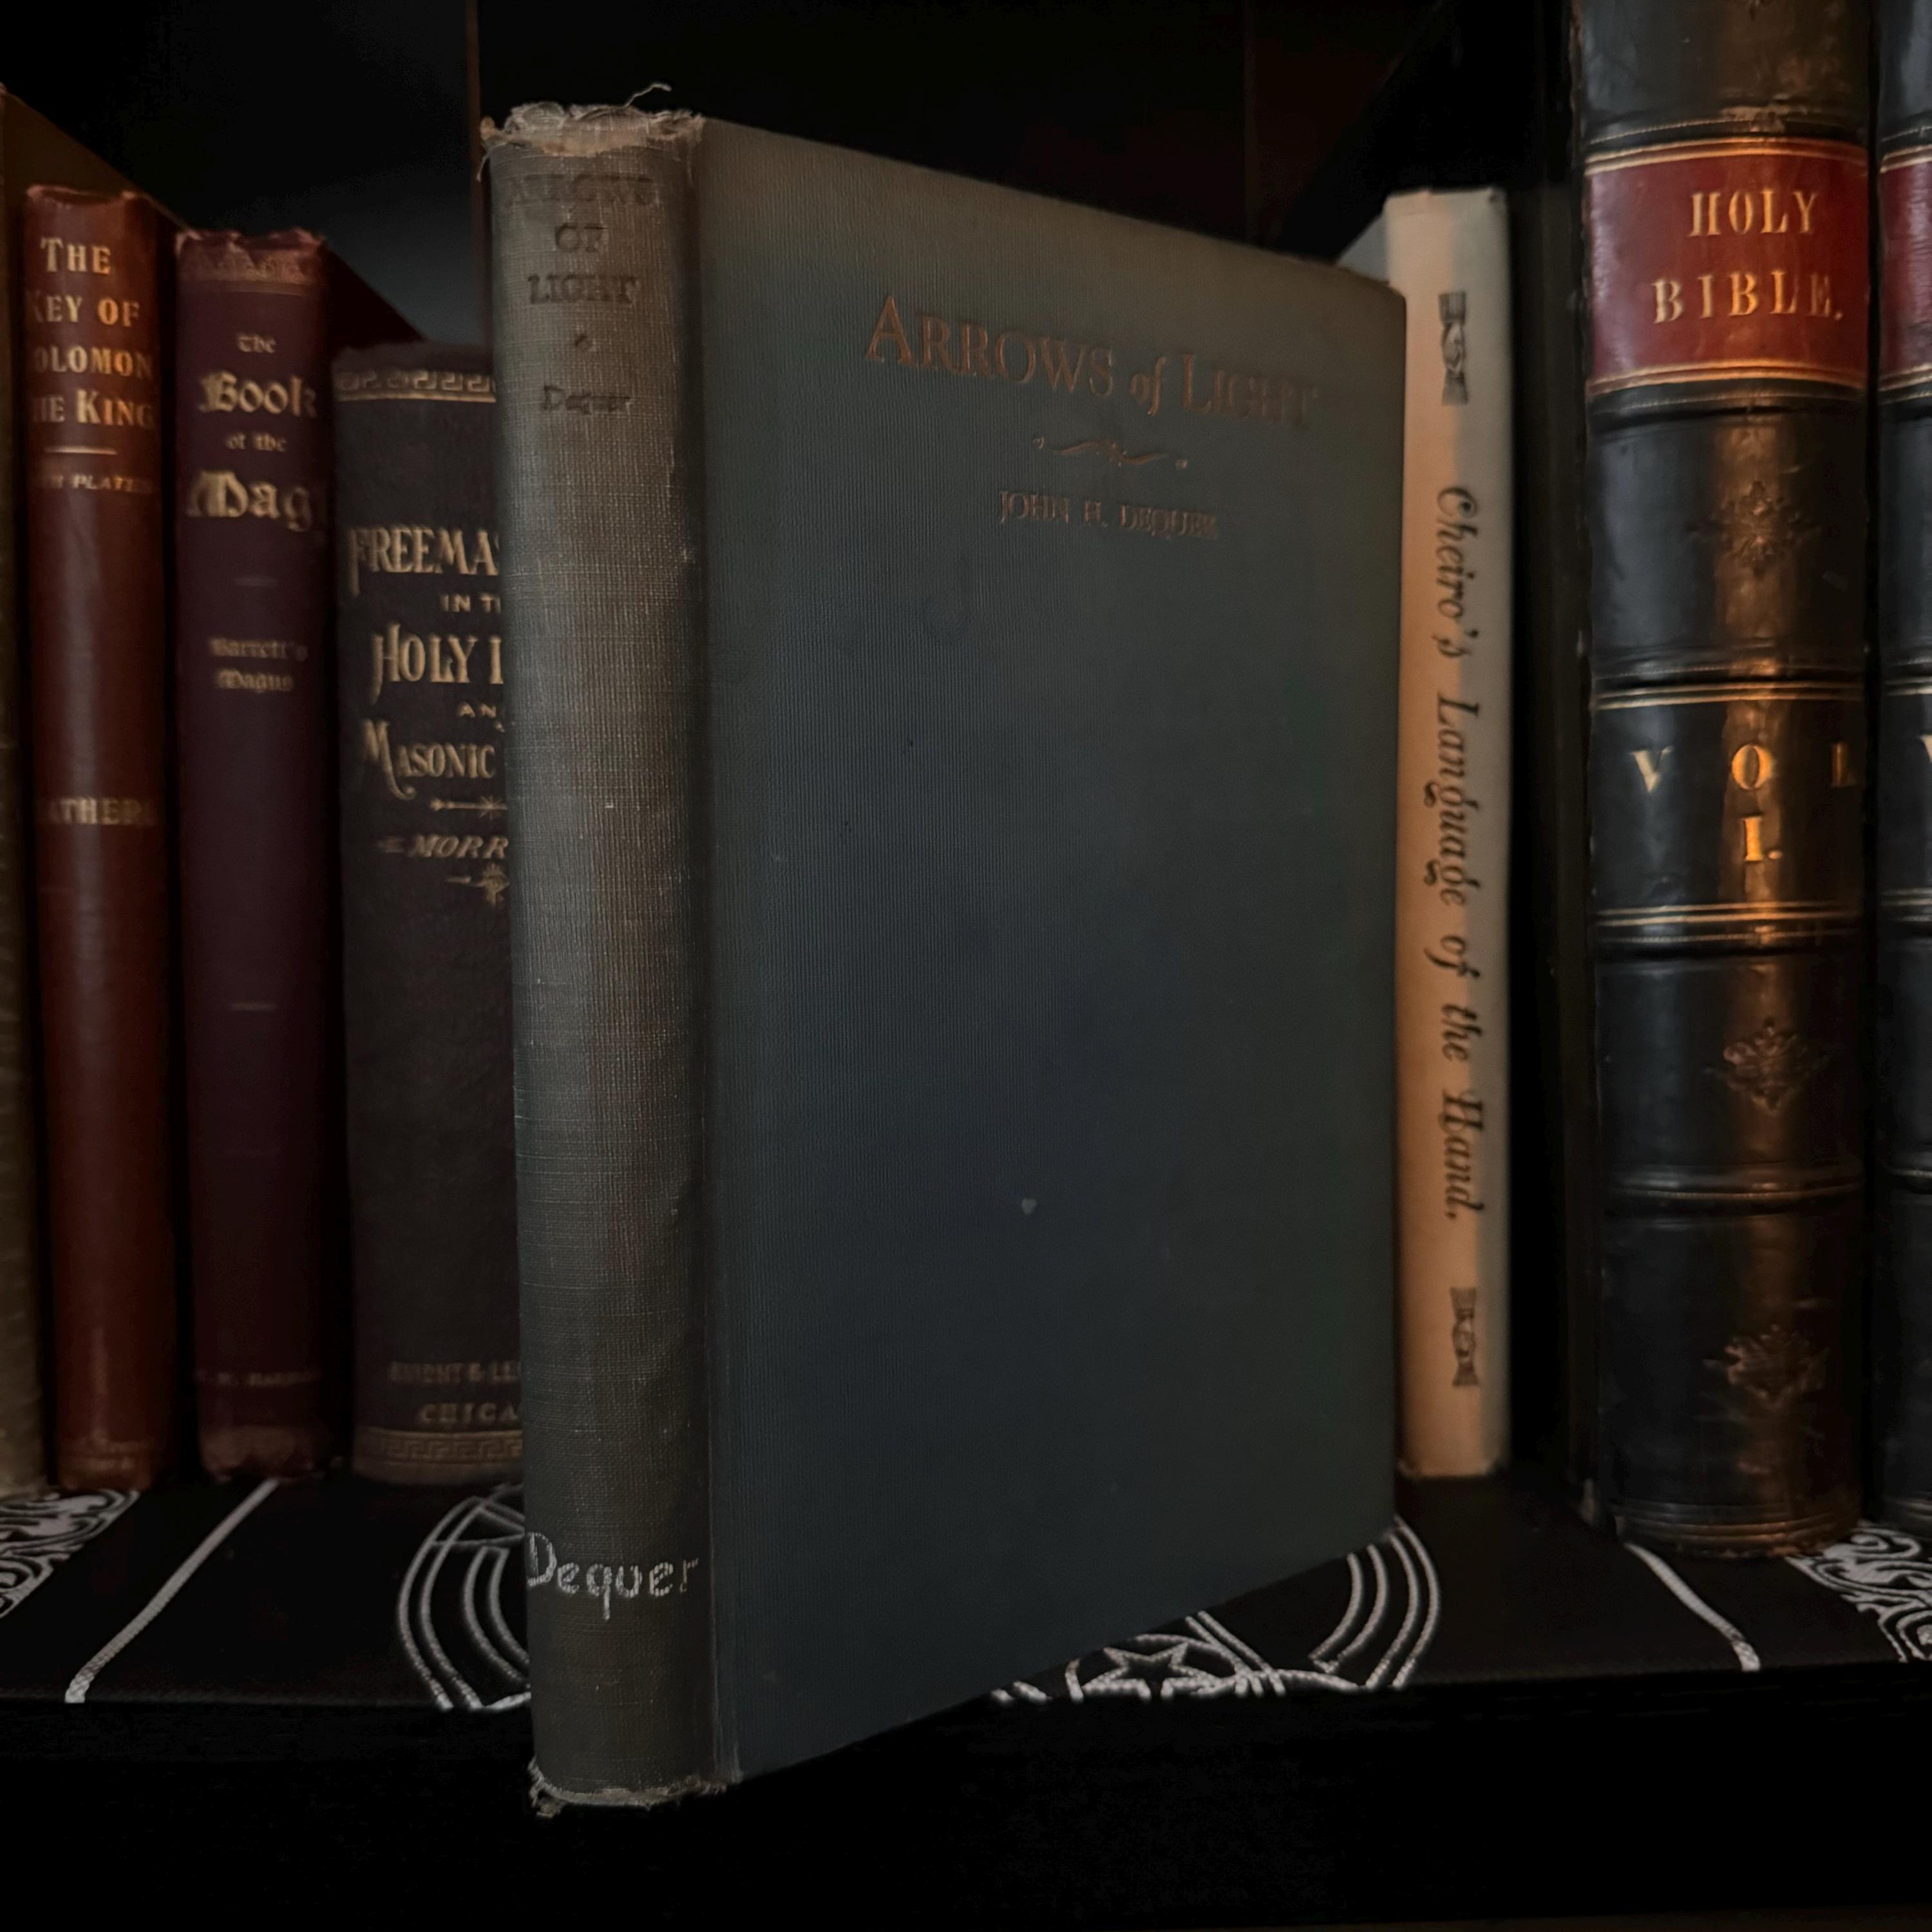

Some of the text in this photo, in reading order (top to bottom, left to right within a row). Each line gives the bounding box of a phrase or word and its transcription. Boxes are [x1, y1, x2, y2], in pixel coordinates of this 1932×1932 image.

[1689, 187, 1819, 238] HOLY
[40, 236, 111, 276] THE
[527, 273, 639, 305] LIGHT
[1651, 268, 1844, 323] BIBLE.
[98, 298, 140, 328] OF
[32, 345, 154, 381] OLOMON
[865, 294, 1320, 429] ARROWS of LIGHT
[30, 388, 156, 430] HE KING
[198, 370, 318, 418] Book
[999, 490, 1070, 526] JOHN
[346, 524, 500, 598] FREEMA
[1435, 484, 1479, 661] Cheiro's
[440, 592, 471, 613] IN
[370, 620, 479, 706] HOLY
[456, 700, 497, 719] AN
[361, 717, 497, 801] MASONIC
[1423, 690, 1481, 907] Language
[406, 833, 509, 860] MORR
[1424, 934, 1481, 980] of
[1441, 1001, 1484, 1063] the
[419, 1401, 521, 1426] CHICA
[526, 1531, 700, 1623] Dequer
